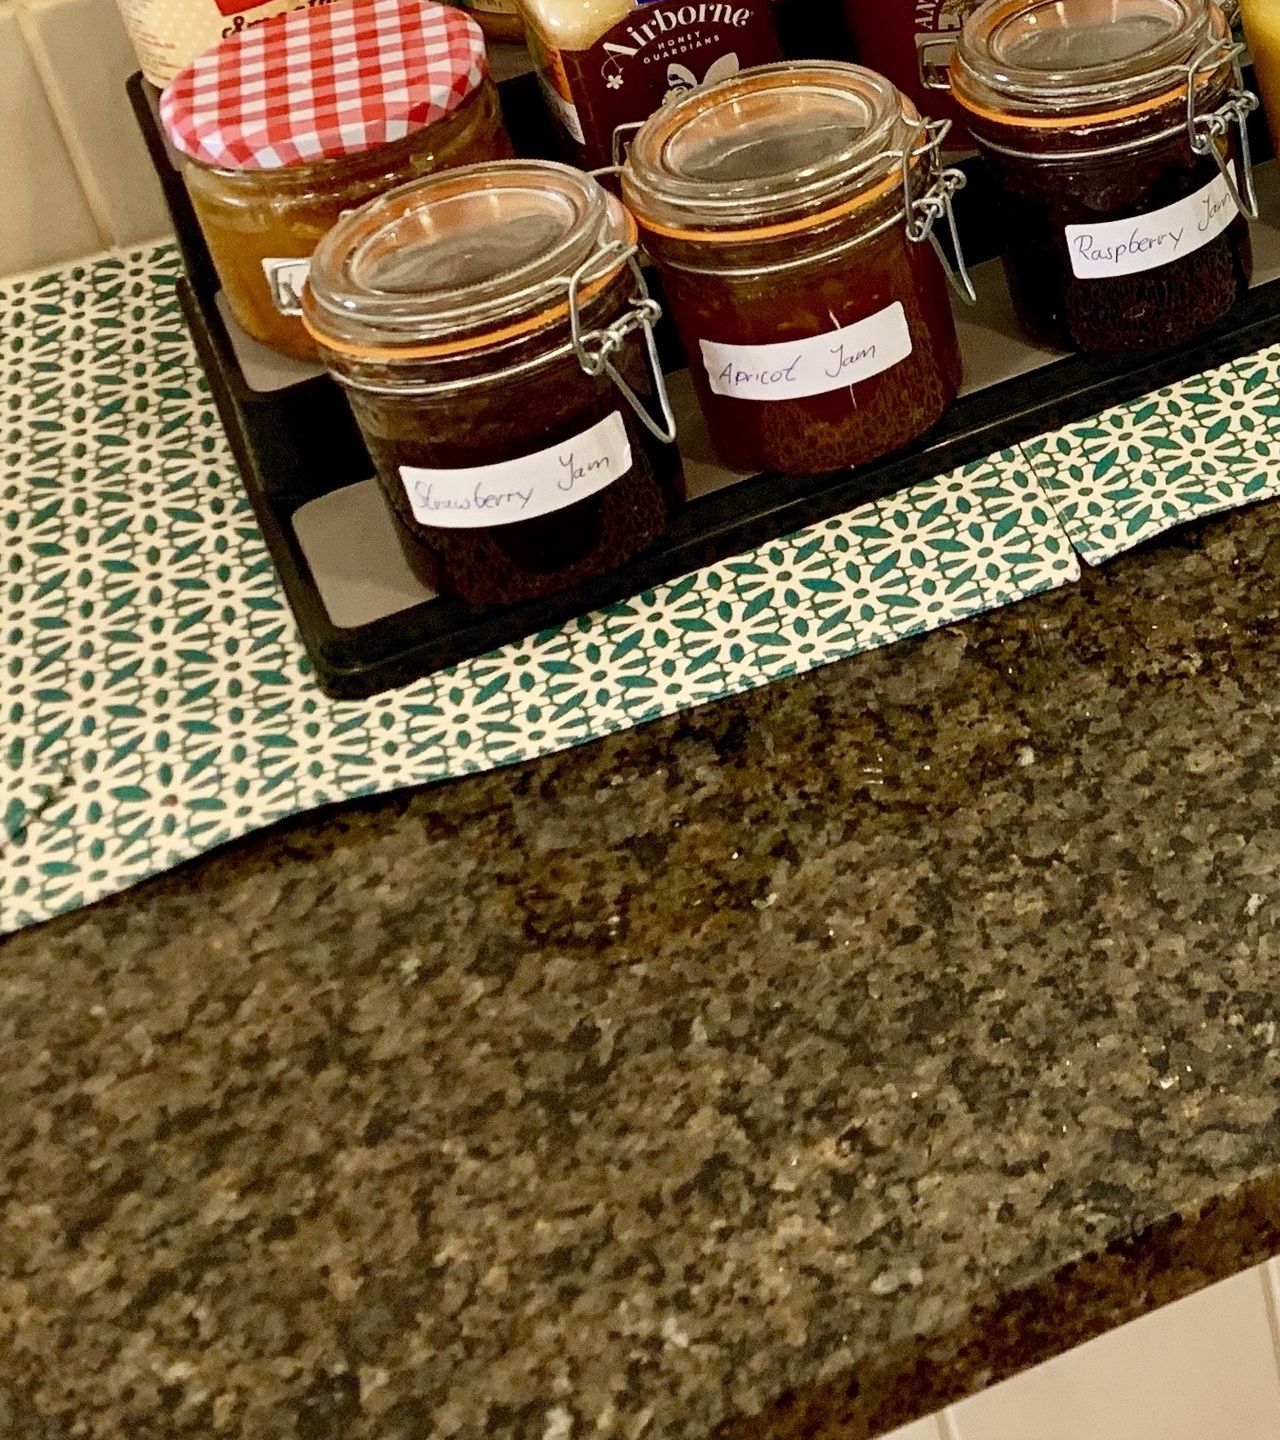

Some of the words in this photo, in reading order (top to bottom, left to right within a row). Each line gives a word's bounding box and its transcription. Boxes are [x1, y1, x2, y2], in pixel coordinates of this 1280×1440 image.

[602, 3, 751, 60] Airborne
[643, 34, 721, 64] GUARDIANS
[657, 31, 701, 50] HONEY
[1073, 227, 1184, 264] Raspberry
[1197, 191, 1233, 232] Jam
[718, 355, 802, 386] Apricot
[825, 343, 876, 379] Jam
